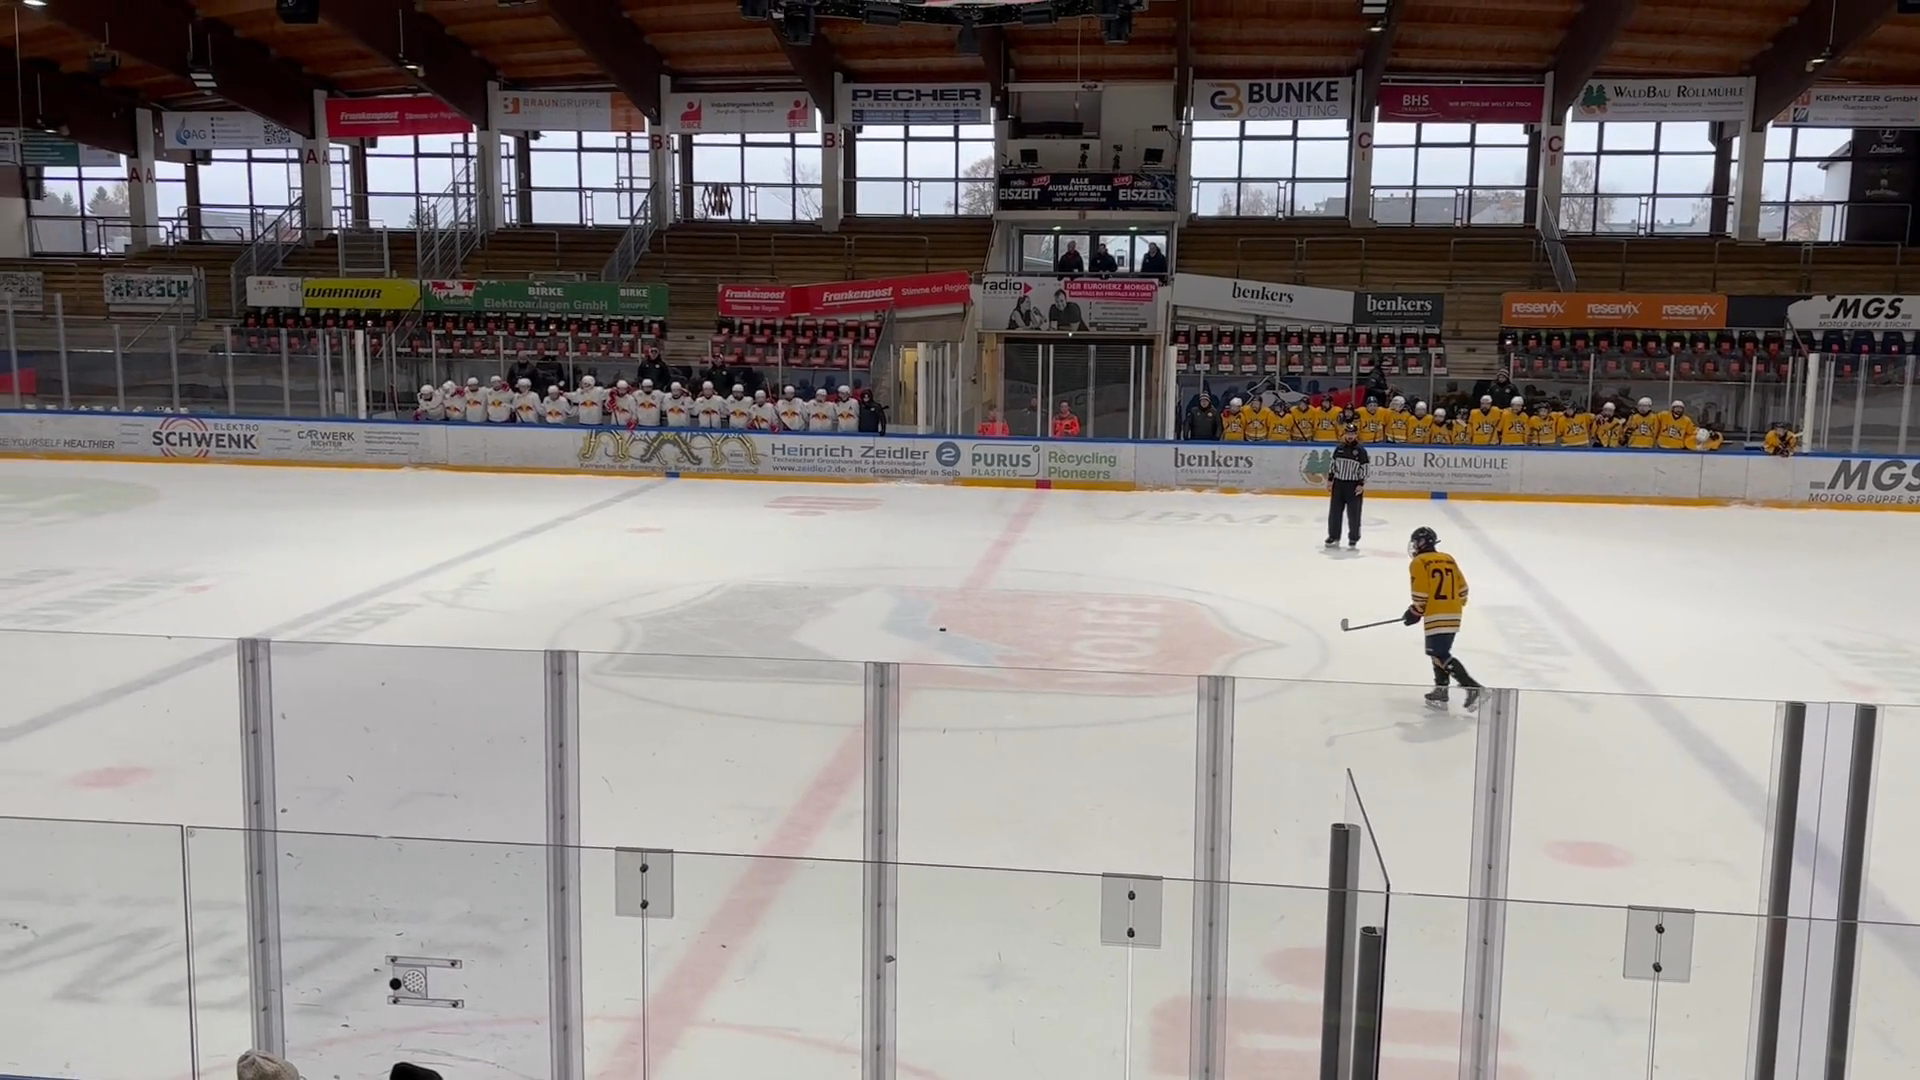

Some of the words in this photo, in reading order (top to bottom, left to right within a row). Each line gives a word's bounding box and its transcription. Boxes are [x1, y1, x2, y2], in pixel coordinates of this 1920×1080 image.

[852, 88, 981, 101] PECHER
[1248, 80, 1339, 103] BUNKE
[1677, 84, 1744, 98] RÖLLMÜHLE
[522, 97, 601, 109] BRAUNGRUPPE
[1402, 94, 1430, 106] BHS
[1815, 94, 1881, 103] KEMNITZER
[1884, 94, 1919, 103] GmbH
[340, 111, 400, 121] Frankenpost
[1247, 104, 1339, 118] CONSULTING
[651, 134, 663, 150] B
[823, 133, 836, 149] B
[1358, 131, 1371, 149] C
[1548, 135, 1562, 153] C
[306, 149, 318, 165] A
[129, 166, 142, 184] A
[1070, 177, 1090, 185] ALLE
[999, 188, 1041, 200] EISZEIT
[1048, 183, 1112, 192] AUSWÄRTSSPIELE
[1118, 189, 1166, 201] EISZEIT
[528, 286, 564, 297] BIRKE
[620, 286, 648, 297] BIRKE
[983, 279, 1022, 290] radio
[725, 289, 785, 300] Frankenpost
[822, 286, 893, 303] Frankenpost
[901, 287, 930, 296] Stimme
[932, 286, 943, 294] der
[1231, 282, 1294, 304] benkers
[484, 298, 570, 311] Elektroanlagen
[573, 299, 609, 311] GmbH
[1366, 294, 1433, 312] benkers
[1511, 301, 1566, 318] reservix
[1831, 298, 1905, 320] MGS
[1586, 302, 1642, 319] reservix
[1662, 302, 1716, 320] reservix
[214, 423, 259, 432] ELEKTRO
[11, 438, 62, 448] YOURSELF
[63, 440, 115, 450] HEALTHIER
[152, 430, 257, 450] SCHWENK
[771, 443, 853, 458] Heinrich
[860, 445, 930, 460] Zeidler
[1049, 450, 1117, 466] Recycling
[1174, 447, 1254, 469] benkers
[971, 453, 1032, 468] PURUS
[1423, 452, 1508, 470] RÖLLMÜHLE
[772, 465, 846, 474] www.zeidler2.de
[867, 466, 930, 476] Grosshändler
[941, 468, 960, 477] Selb
[972, 468, 1018, 477] PLASTICS
[1049, 466, 1110, 480] Pioneers
[1808, 492, 1853, 503] MOTOR
[1857, 494, 1904, 504] GRUPPE
[1431, 568, 1456, 600] 27
